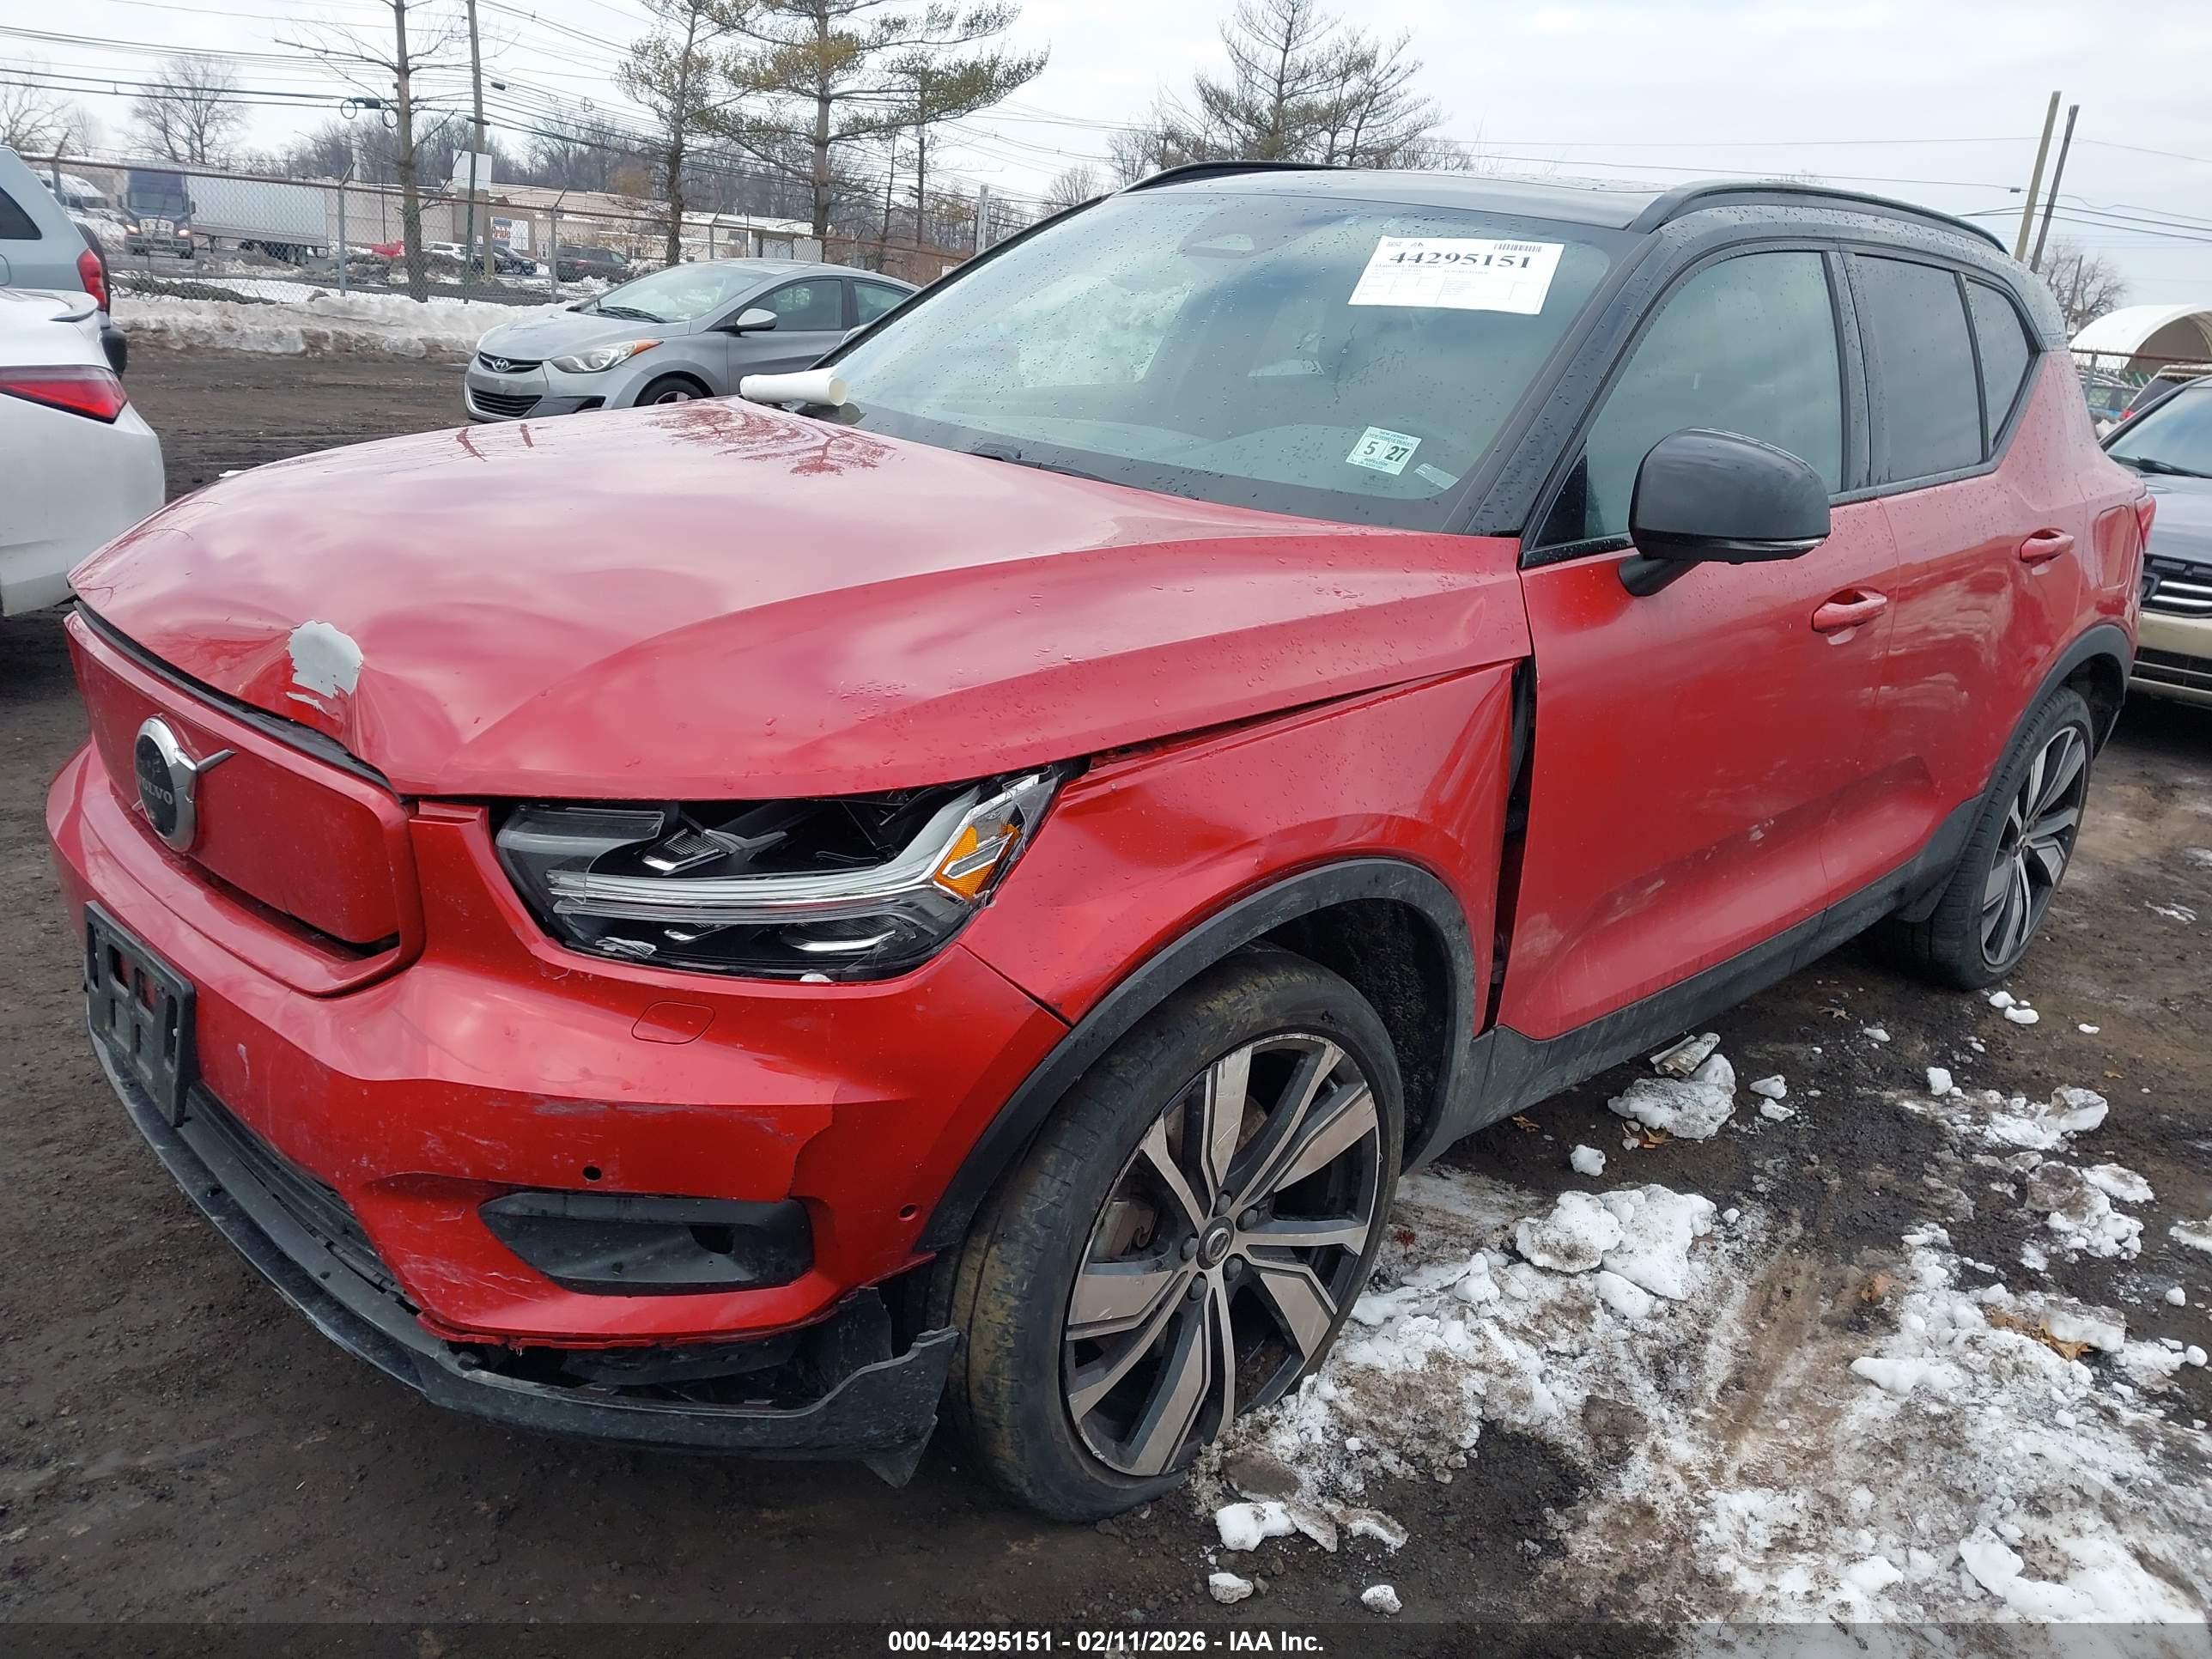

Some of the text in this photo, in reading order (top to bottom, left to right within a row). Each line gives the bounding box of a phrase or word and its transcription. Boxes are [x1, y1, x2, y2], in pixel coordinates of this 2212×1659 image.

[1389, 252, 1531, 269] 44295151
[1364, 441, 1379, 455] 5
[1384, 446, 1410, 462] 27
